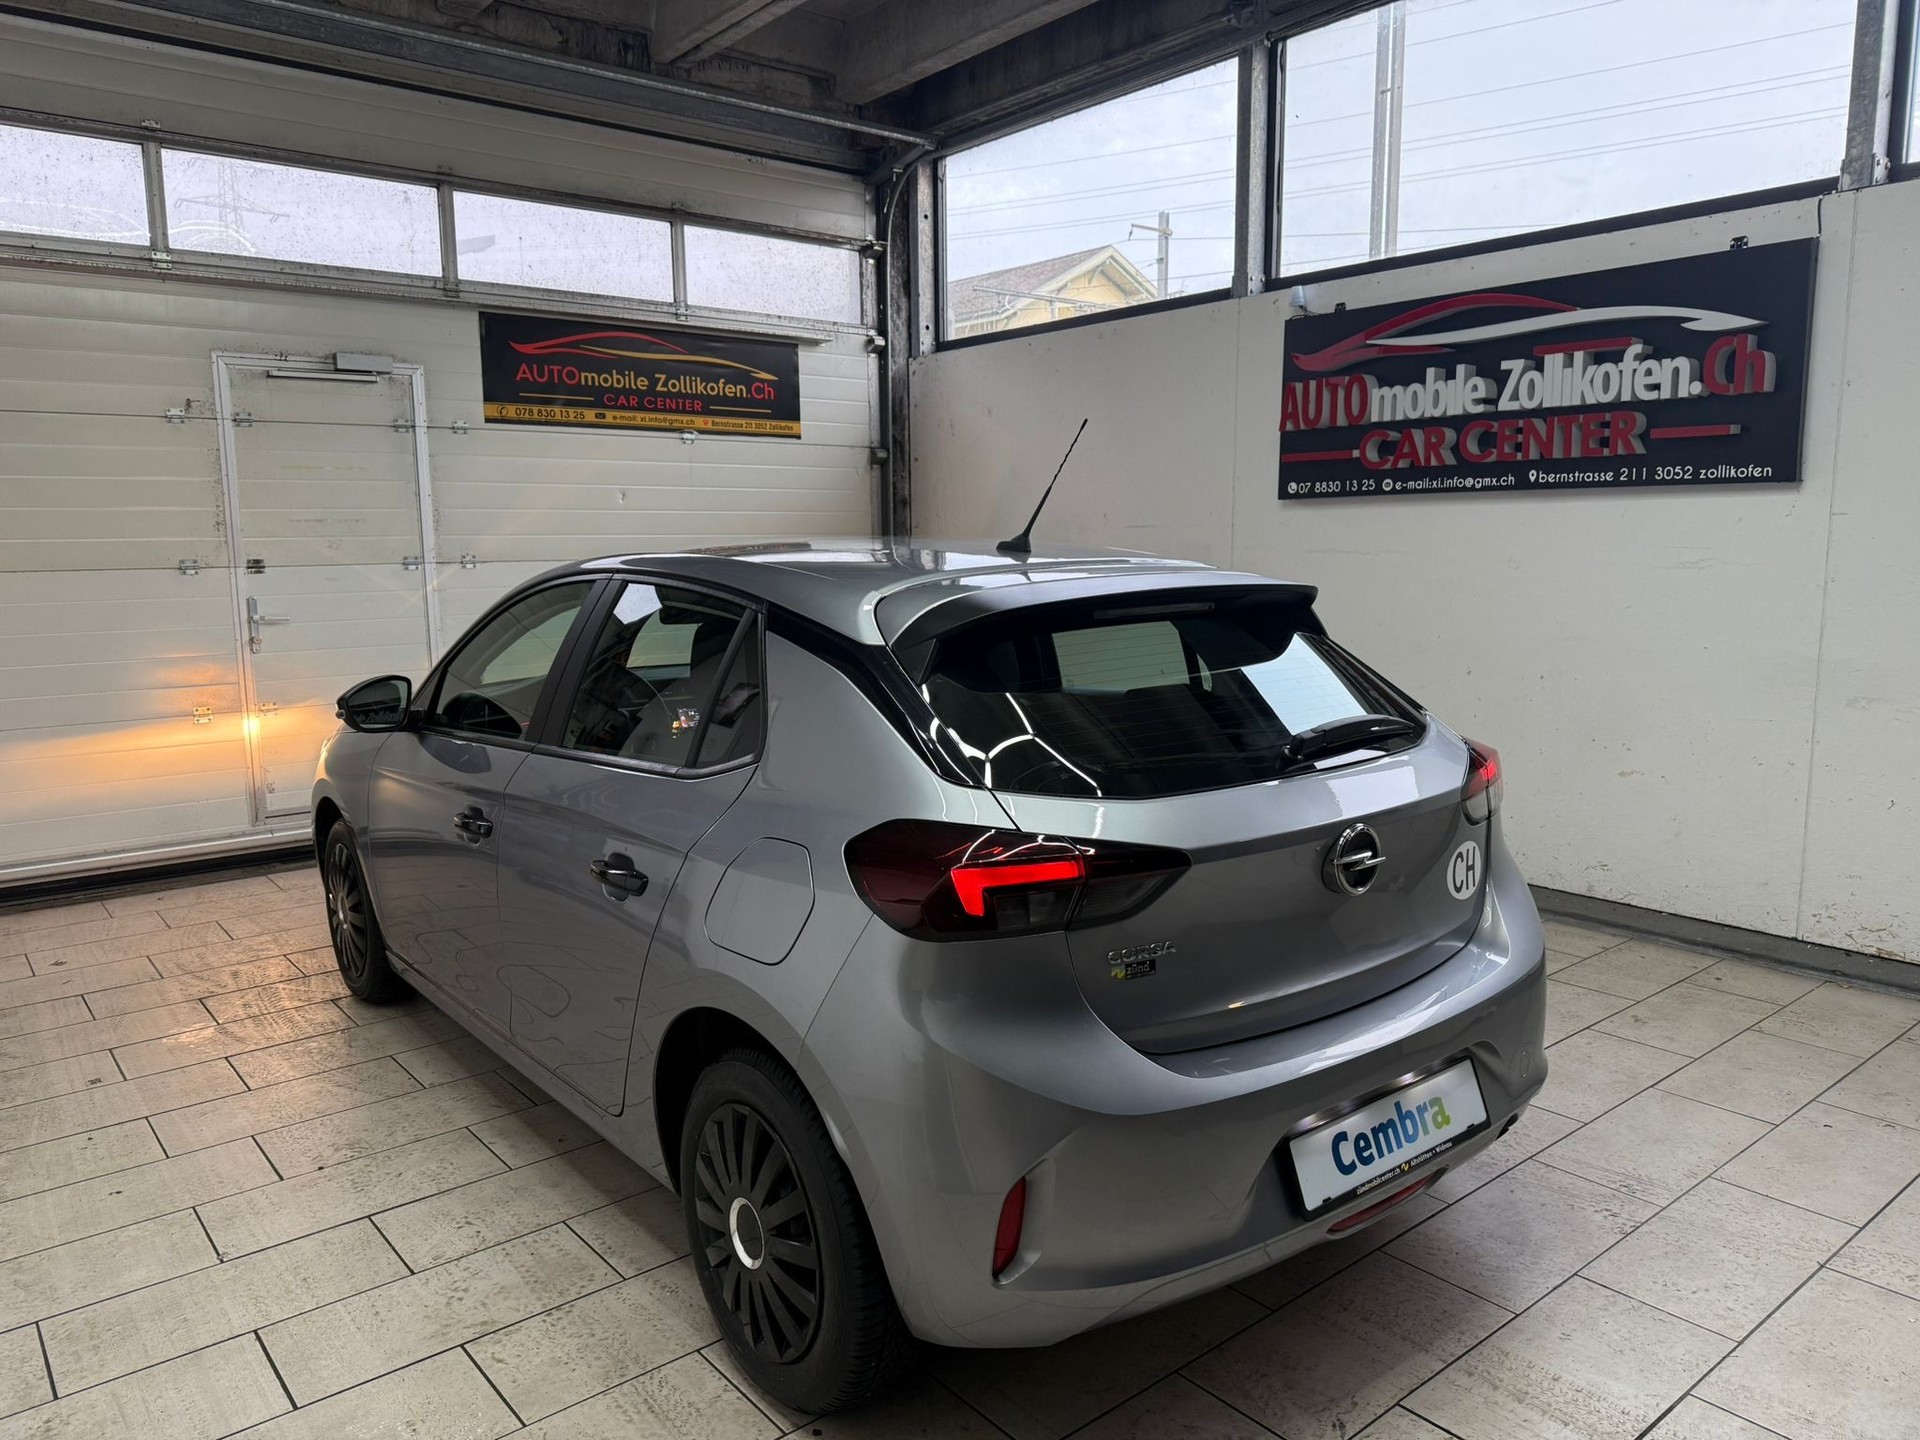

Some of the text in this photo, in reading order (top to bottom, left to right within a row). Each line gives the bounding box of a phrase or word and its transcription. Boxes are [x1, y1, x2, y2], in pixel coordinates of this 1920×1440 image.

[516, 363, 775, 400] AUTOmobile Zollikofen.Ch
[515, 407, 534, 416] 078
[537, 408, 556, 418] 830
[559, 409, 570, 419] 13
[573, 410, 585, 420] 25
[754, 422, 768, 430] 3052
[603, 393, 703, 412] CAR CENTER
[1359, 410, 1642, 470] CAR CENTER
[1298, 482, 1311, 494] 07
[1314, 481, 1341, 493] 8830
[1346, 480, 1358, 491] 13
[1361, 479, 1376, 491] 25
[1539, 470, 1614, 483] bernstrasse
[1620, 468, 1648, 481] 211
[1655, 466, 1693, 480] 3052
[1699, 464, 1772, 479] zollikofen
[1452, 846, 1476, 893] CH
[1107, 941, 1177, 964] CORSA
[1331, 1096, 1451, 1176] Cembra
